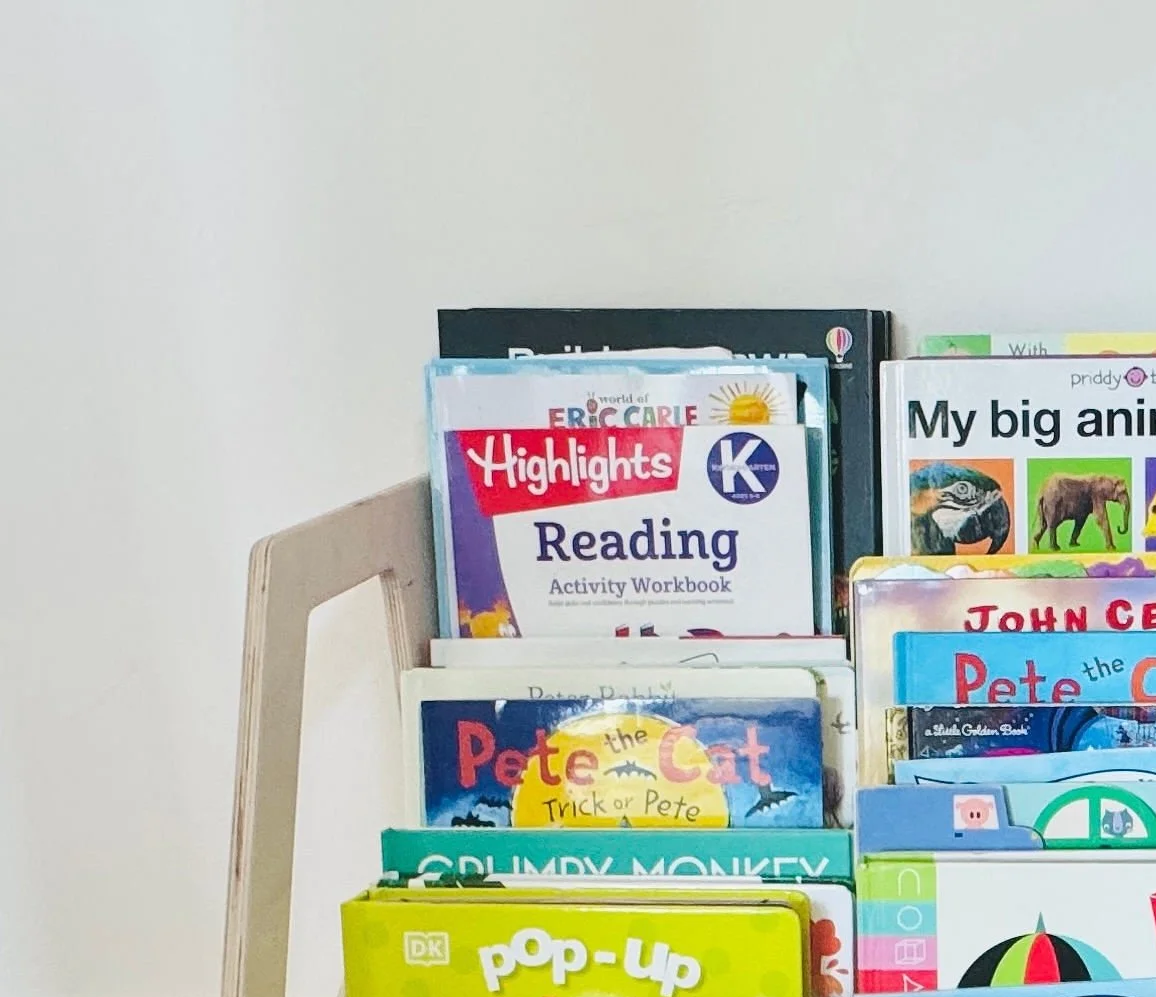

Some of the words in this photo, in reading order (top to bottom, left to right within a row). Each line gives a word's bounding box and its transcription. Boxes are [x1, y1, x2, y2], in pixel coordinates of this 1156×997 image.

[1009, 342, 1048, 356] With
[1071, 370, 1122, 390] priddy
[599, 393, 634, 404] world
[638, 393, 650, 404] of
[624, 405, 697, 428] CARLE
[908, 400, 977, 448] My
[991, 399, 1061, 448] big
[468, 434, 674, 495] Highlights
[721, 440, 767, 493] K
[535, 518, 739, 572] Reading
[549, 577, 627, 598] Activity
[631, 576, 732, 594] Workbook
[964, 605, 1087, 633] JOHN
[955, 653, 1081, 706] Pete
[1083, 656, 1124, 682] the
[925, 728, 933, 737] a
[933, 723, 961, 736] Little
[962, 723, 1000, 737] Golden
[1000, 723, 1028, 736] Book
[457, 720, 599, 789] Pete
[605, 727, 649, 755] the
[658, 722, 773, 787] Cat
[544, 793, 606, 819] Trick
[614, 797, 634, 811] or
[645, 790, 701, 824] Pete
[410, 940, 443, 961] DK
[479, 928, 702, 997] pop-up
